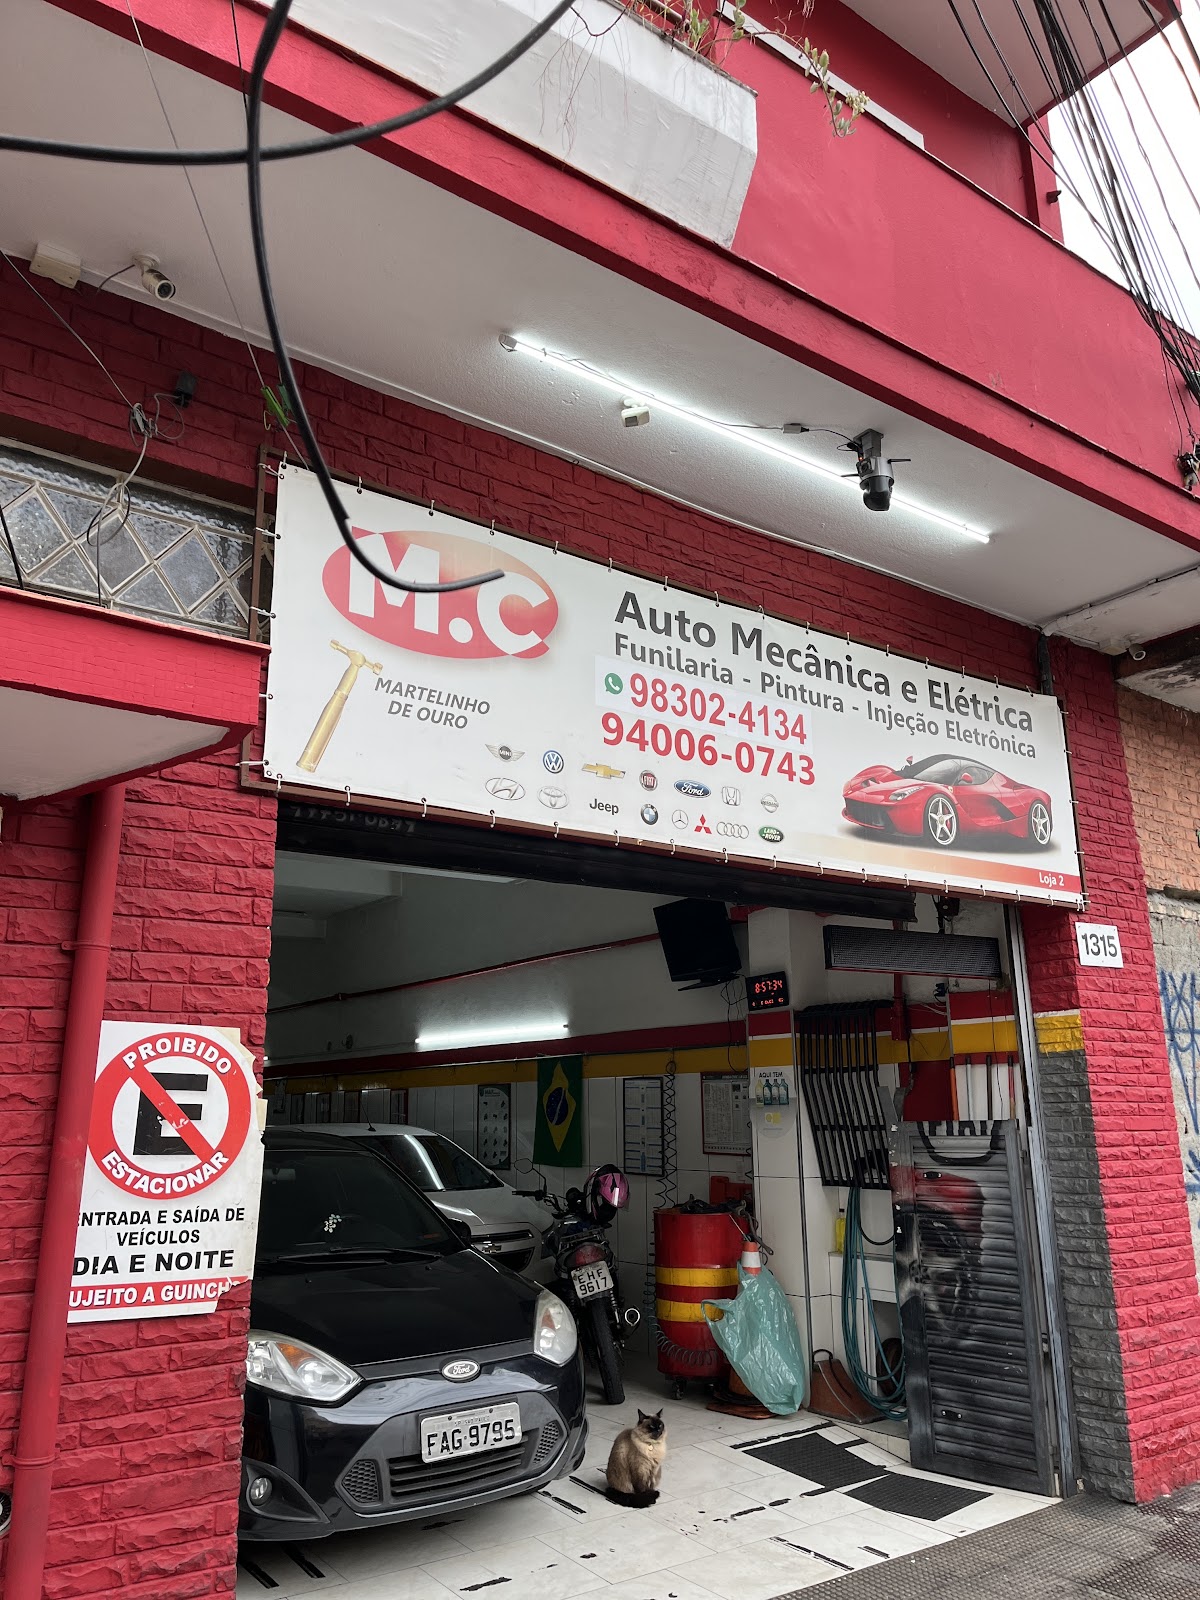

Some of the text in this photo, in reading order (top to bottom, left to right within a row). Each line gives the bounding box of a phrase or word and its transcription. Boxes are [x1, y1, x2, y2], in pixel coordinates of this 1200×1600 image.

[614, 590, 1033, 733] Auto Mecânica e Elétrica
[374, 677, 491, 715] MARTELINHO
[615, 632, 733, 685] Funilaria
[760, 671, 844, 713] Pintura
[867, 699, 939, 736] Injeção
[945, 719, 1036, 759] Eletrônica
[629, 672, 807, 745] 98302-4134
[388, 700, 468, 729] DE OURO
[601, 711, 815, 786] 94006-0743
[681, 782, 704, 797] Ford
[589, 798, 619, 815] Jeep
[1038, 871, 1065, 888] Loja 2
[1081, 932, 1118, 958] 1315
[121, 1036, 233, 1076] PROIBIDO
[100, 1150, 230, 1195] ESTACIONAR
[77, 1205, 245, 1227] NTRADA E SAÍDA DE
[116, 1227, 200, 1247] VEÍCULOS
[72, 1249, 235, 1276] DIA E NOITE
[577, 1268, 603, 1284] EHF
[68, 1280, 241, 1308] UJEITO A GUINCH
[579, 1276, 607, 1296] 9617
[452, 1363, 471, 1375] Ford
